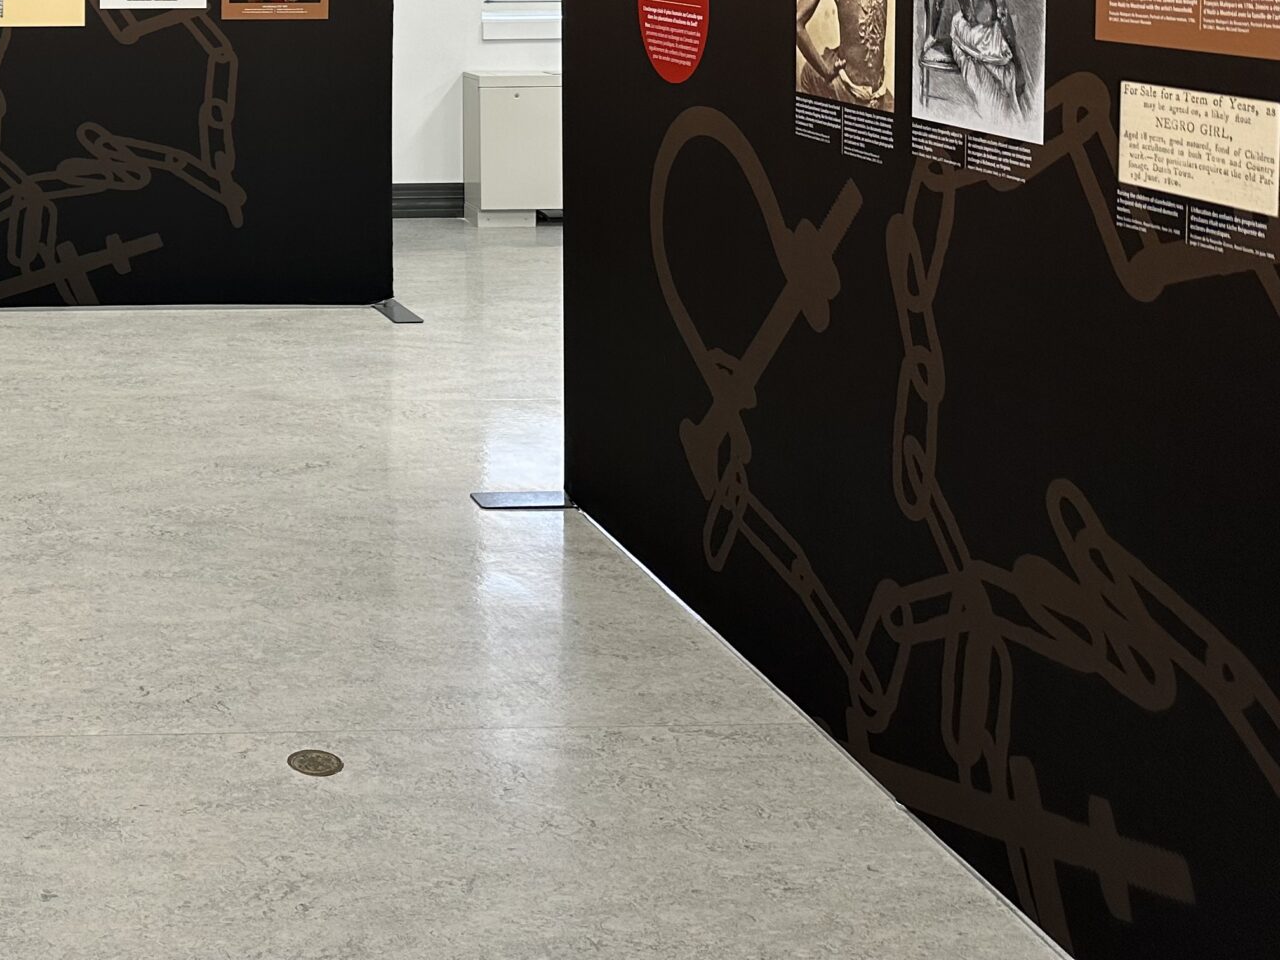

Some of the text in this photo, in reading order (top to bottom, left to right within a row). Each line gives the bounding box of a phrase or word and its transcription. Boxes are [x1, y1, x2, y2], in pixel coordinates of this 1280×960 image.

[1124, 84, 1138, 96] For
[1140, 85, 1156, 97] Sale
[1161, 88, 1173, 100] for
[1183, 92, 1208, 105] Term
[1213, 97, 1223, 108] of
[1229, 98, 1259, 116] Years,
[1266, 108, 1276, 116] as
[1156, 117, 1233, 141] NEGRO GIRL,
[1124, 131, 1138, 140] Aged
[1234, 147, 1242, 156] of
[1245, 150, 1274, 164] Children
[1206, 153, 1226, 164] Town
[1230, 158, 1241, 168] and
[1246, 162, 1274, 175] Country
[1231, 169, 1241, 178] the
[1245, 172, 1256, 181] old
